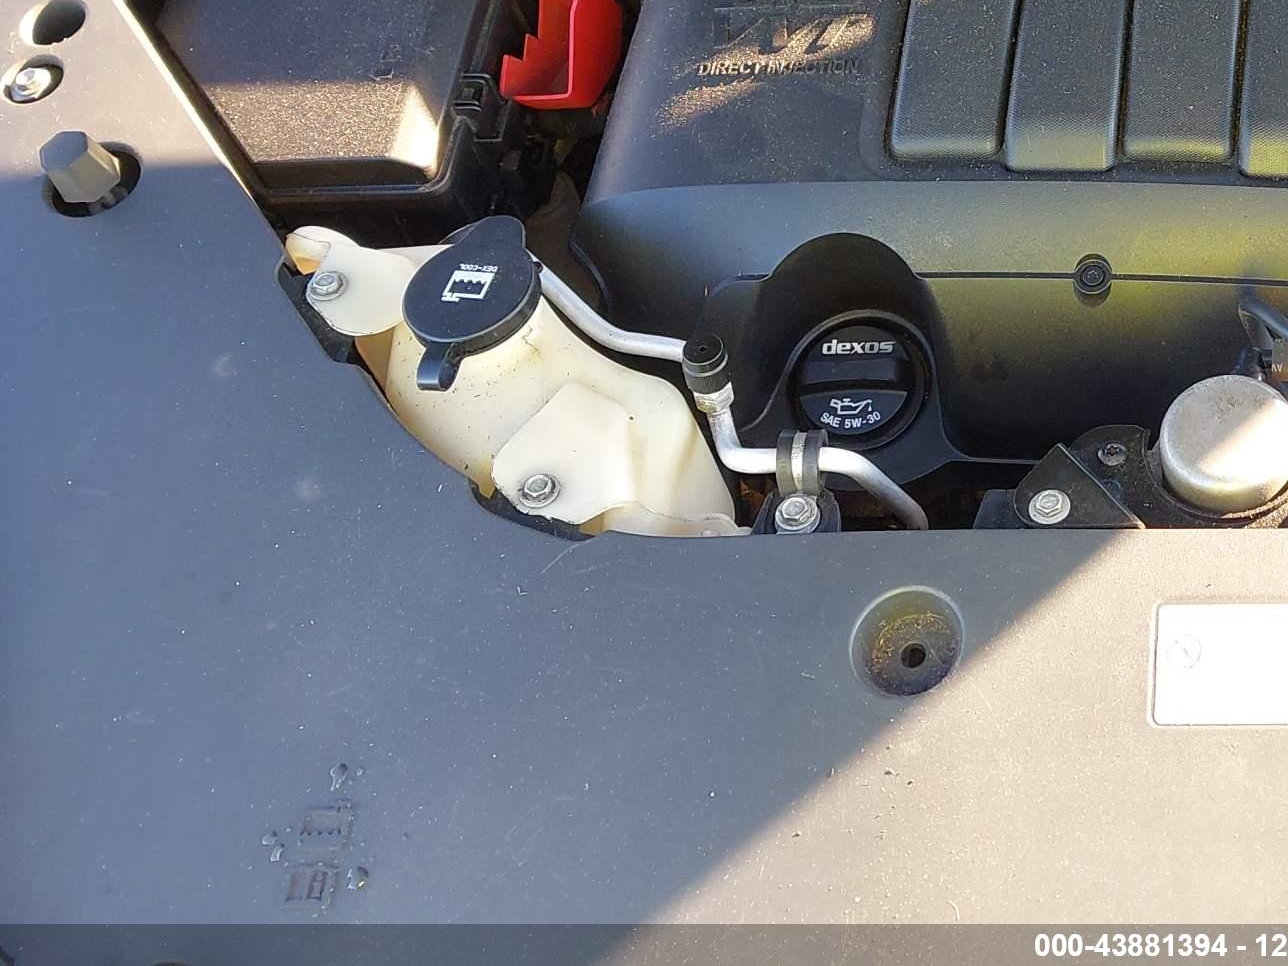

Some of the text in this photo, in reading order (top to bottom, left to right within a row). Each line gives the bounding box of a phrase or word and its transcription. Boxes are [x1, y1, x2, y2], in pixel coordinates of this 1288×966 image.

[697, 57, 860, 76] DIRECT INJECTION
[459, 263, 498, 272] DEX-COOL
[821, 338, 896, 355] dexos
[820, 411, 881, 429] SAE 5W-30
